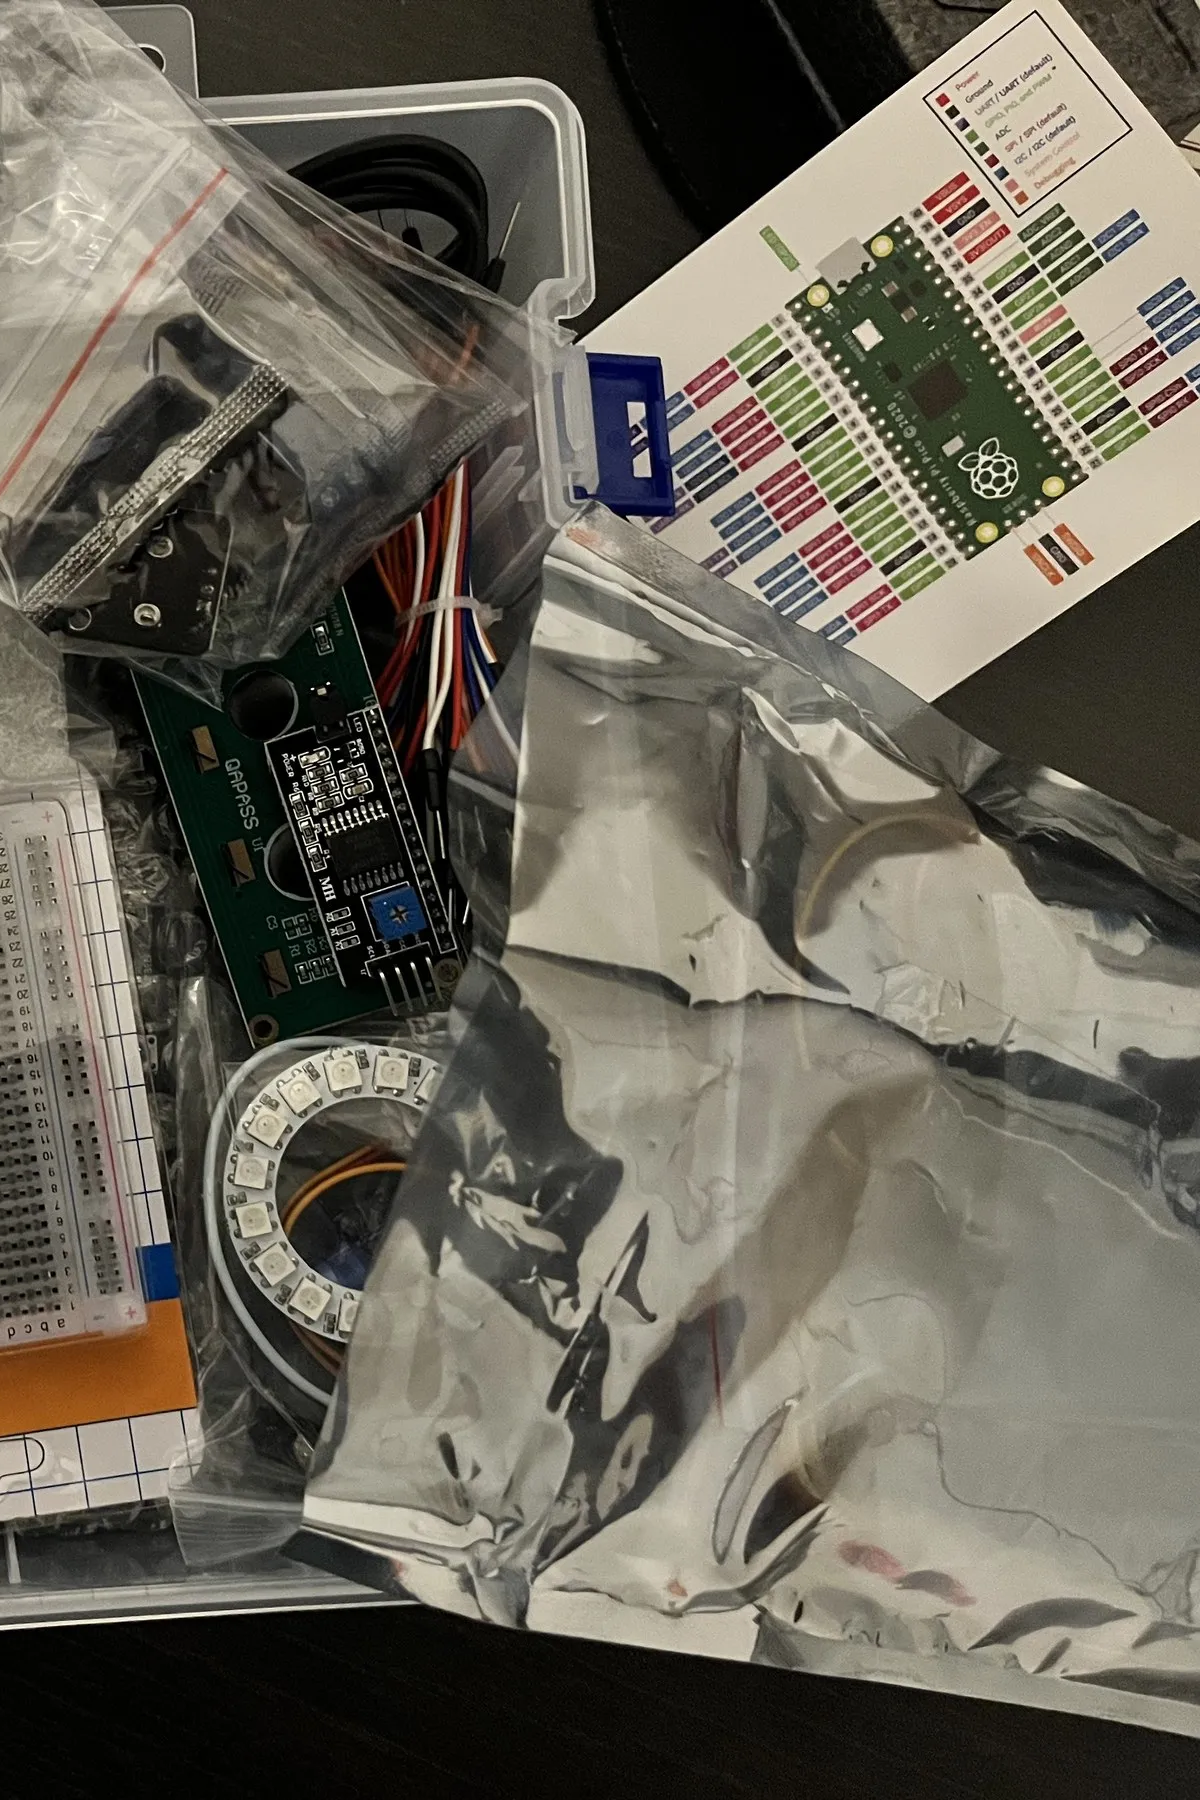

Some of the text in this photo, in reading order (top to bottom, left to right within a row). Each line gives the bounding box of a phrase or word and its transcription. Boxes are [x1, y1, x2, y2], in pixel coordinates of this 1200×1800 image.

[974, 97, 996, 116] UART
[998, 77, 1021, 97] UART
[1018, 52, 1054, 82] (default)
[964, 78, 994, 104] Ground
[993, 124, 1011, 140] ADC
[1003, 139, 1018, 153] SPI
[1023, 124, 1037, 138] SPI
[1034, 101, 1068, 129] (default)
[1013, 151, 1028, 165] I2C
[1031, 137, 1046, 151] I2C
[1043, 114, 1077, 142] (default)
[353, 717, 363, 732] LED
[282, 753, 294, 778] POWER
[225, 758, 259, 830] QAPASS
[319, 876, 336, 902] MH
[1, 894, 13, 905] 26
[3, 910, 16, 920] 25
[6, 925, 19, 935] 24
[8, 941, 21, 951] 23
[367, 945, 376, 958] SCL
[11, 957, 23, 967] 22
[13, 973, 25, 983] 21
[26, 1053, 37, 1063] 16
[29, 1069, 40, 1079] 15
[34, 1101, 46, 1112] 13
[36, 1117, 48, 1128] 12
[23, 1324, 32, 1334] c
[40, 1321, 48, 1332] b
[57, 1318, 65, 1329] a
[7, 1326, 16, 1338] d
